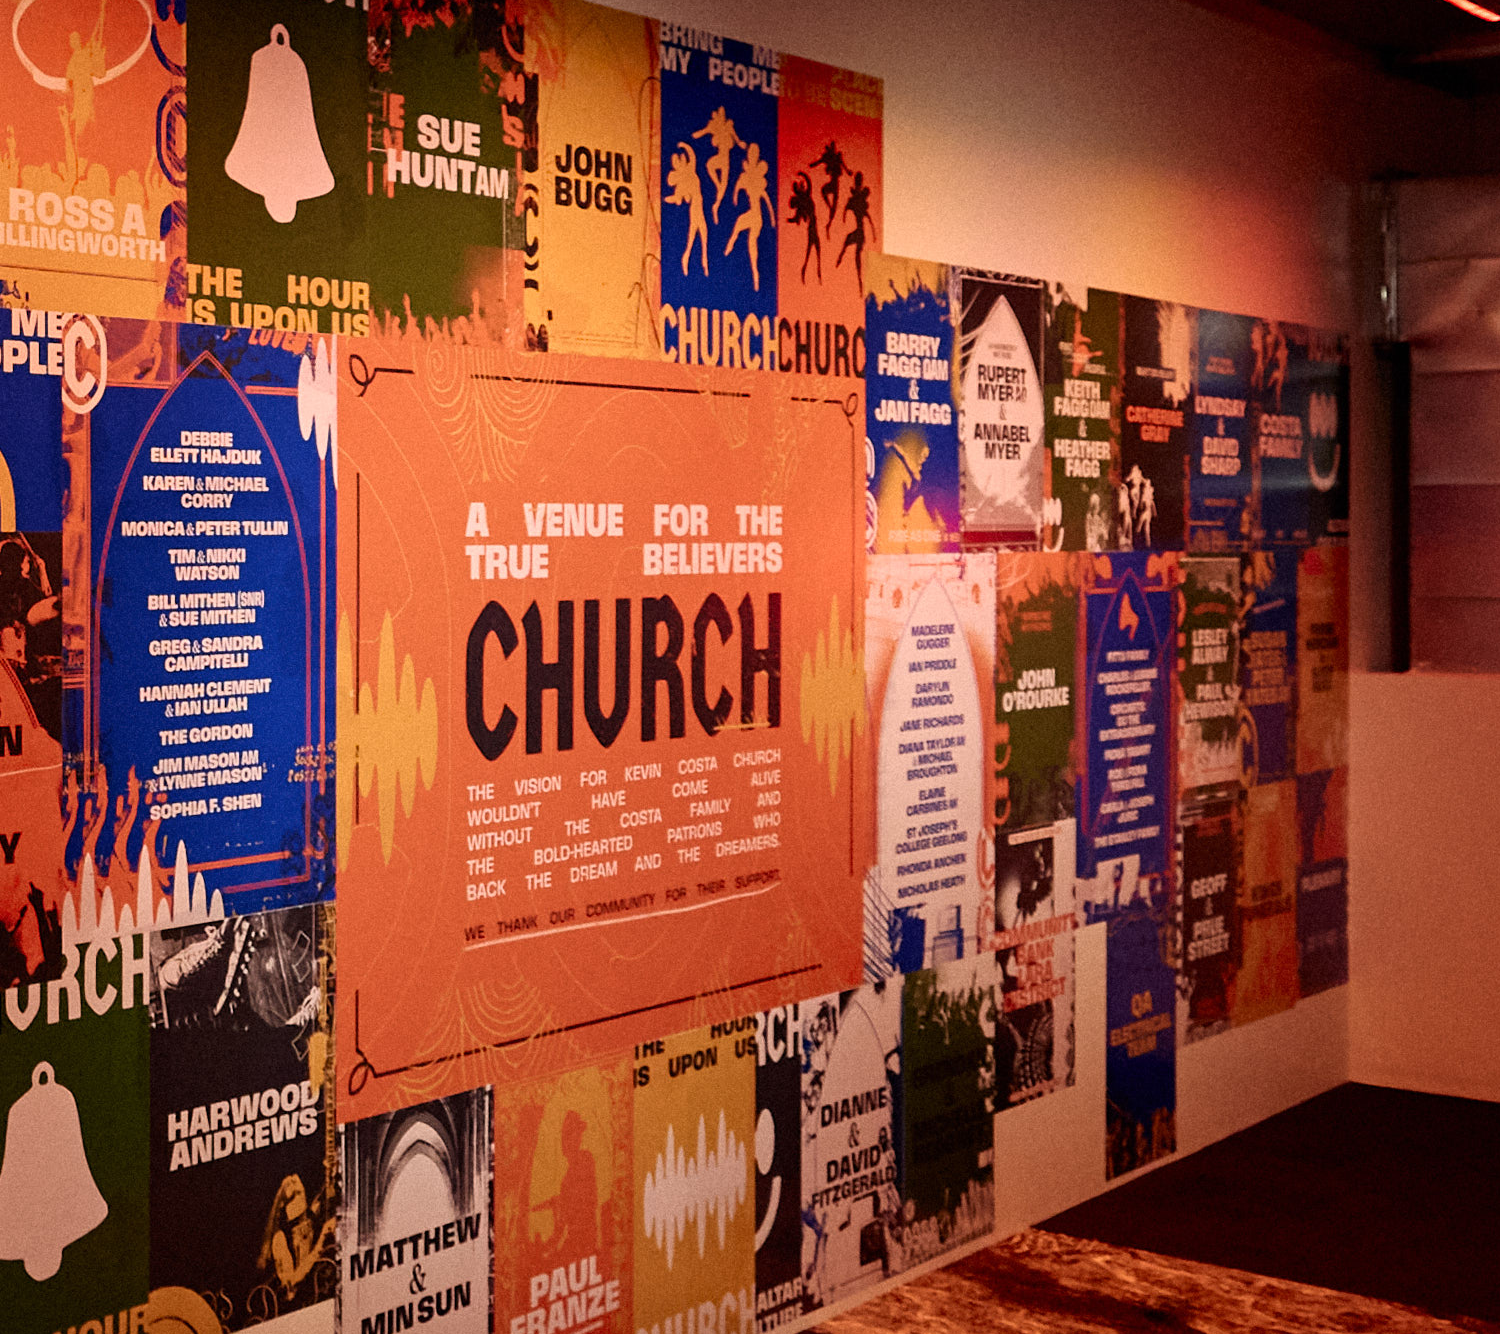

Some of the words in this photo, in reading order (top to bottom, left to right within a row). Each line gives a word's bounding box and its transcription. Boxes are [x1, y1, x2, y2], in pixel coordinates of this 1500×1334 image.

[660, 45, 691, 75] MY
[709, 57, 780, 96] PEOPLE
[417, 114, 481, 157] SUE
[556, 144, 632, 183] JOHN
[9, 187, 115, 232] ROSS
[121, 203, 147, 237] A
[555, 176, 633, 215] BUGG
[186, 263, 243, 299] THE
[287, 274, 370, 310] HOUR
[660, 303, 778, 371] CHURCH
[886, 332, 940, 357] BARRY
[878, 354, 921, 377] FAGG
[978, 365, 1026, 384] RUPERT
[181, 431, 233, 447] DEBBIE
[974, 424, 1030, 443] ANNABEL
[1054, 438, 1111, 460] HEATHER
[143, 476, 195, 491] KAREN
[205, 477, 269, 492] MICHAEL
[181, 494, 234, 508] CORRY
[121, 521, 185, 536] MONICA
[196, 521, 240, 536] PETER
[466, 502, 489, 538] A
[523, 503, 624, 537] VENUE
[654, 504, 709, 536] FOR
[735, 505, 783, 535] THE
[175, 565, 240, 581] WATSON
[466, 544, 548, 579] TRUE
[643, 543, 783, 575] BELIEVERS
[179, 592, 235, 609] MITHEN
[466, 593, 781, 761] CHURCH
[1017, 668, 1056, 690] JOHN
[1002, 687, 1070, 712] O'ROURKE
[467, 783, 494, 802] THE
[514, 776, 562, 796] VISION
[580, 770, 607, 788] FOR
[625, 764, 662, 782] KEVIN
[678, 756, 718, 775] COSTA
[733, 749, 781, 768] CHURCH
[467, 802, 541, 827] WOULDN'T
[592, 791, 626, 809] HAVE
[672, 779, 708, 797] COME
[751, 770, 781, 787] ALIVE
[467, 827, 532, 851] WITHOUT
[565, 819, 590, 836] THE
[620, 809, 662, 828] COSTA
[690, 799, 731, 817] FAMILY
[757, 791, 781, 808] AND
[467, 857, 494, 876] THE
[534, 835, 633, 865] BOLD-HEARTED
[667, 822, 722, 843] PATRONS
[753, 812, 781, 829] WHO
[466, 880, 506, 901] BACK
[525, 873, 552, 891] THE
[570, 862, 618, 883] DREAM
[634, 854, 662, 872] AND
[677, 847, 700, 864] THE
[497, 916, 538, 935] THANK
[586, 893, 655, 918] COMMUNITY
[669, 1047, 718, 1077] UPON
[168, 1080, 320, 1142] HARWOOD
[821, 1086, 888, 1128] DIANNE
[169, 1107, 318, 1172] ANDREWS
[827, 1146, 880, 1183] DAVID
[811, 1167, 897, 1209] FITZGERALD
[350, 1212, 482, 1281] MATTHEW
[531, 1255, 602, 1307] PAUL
